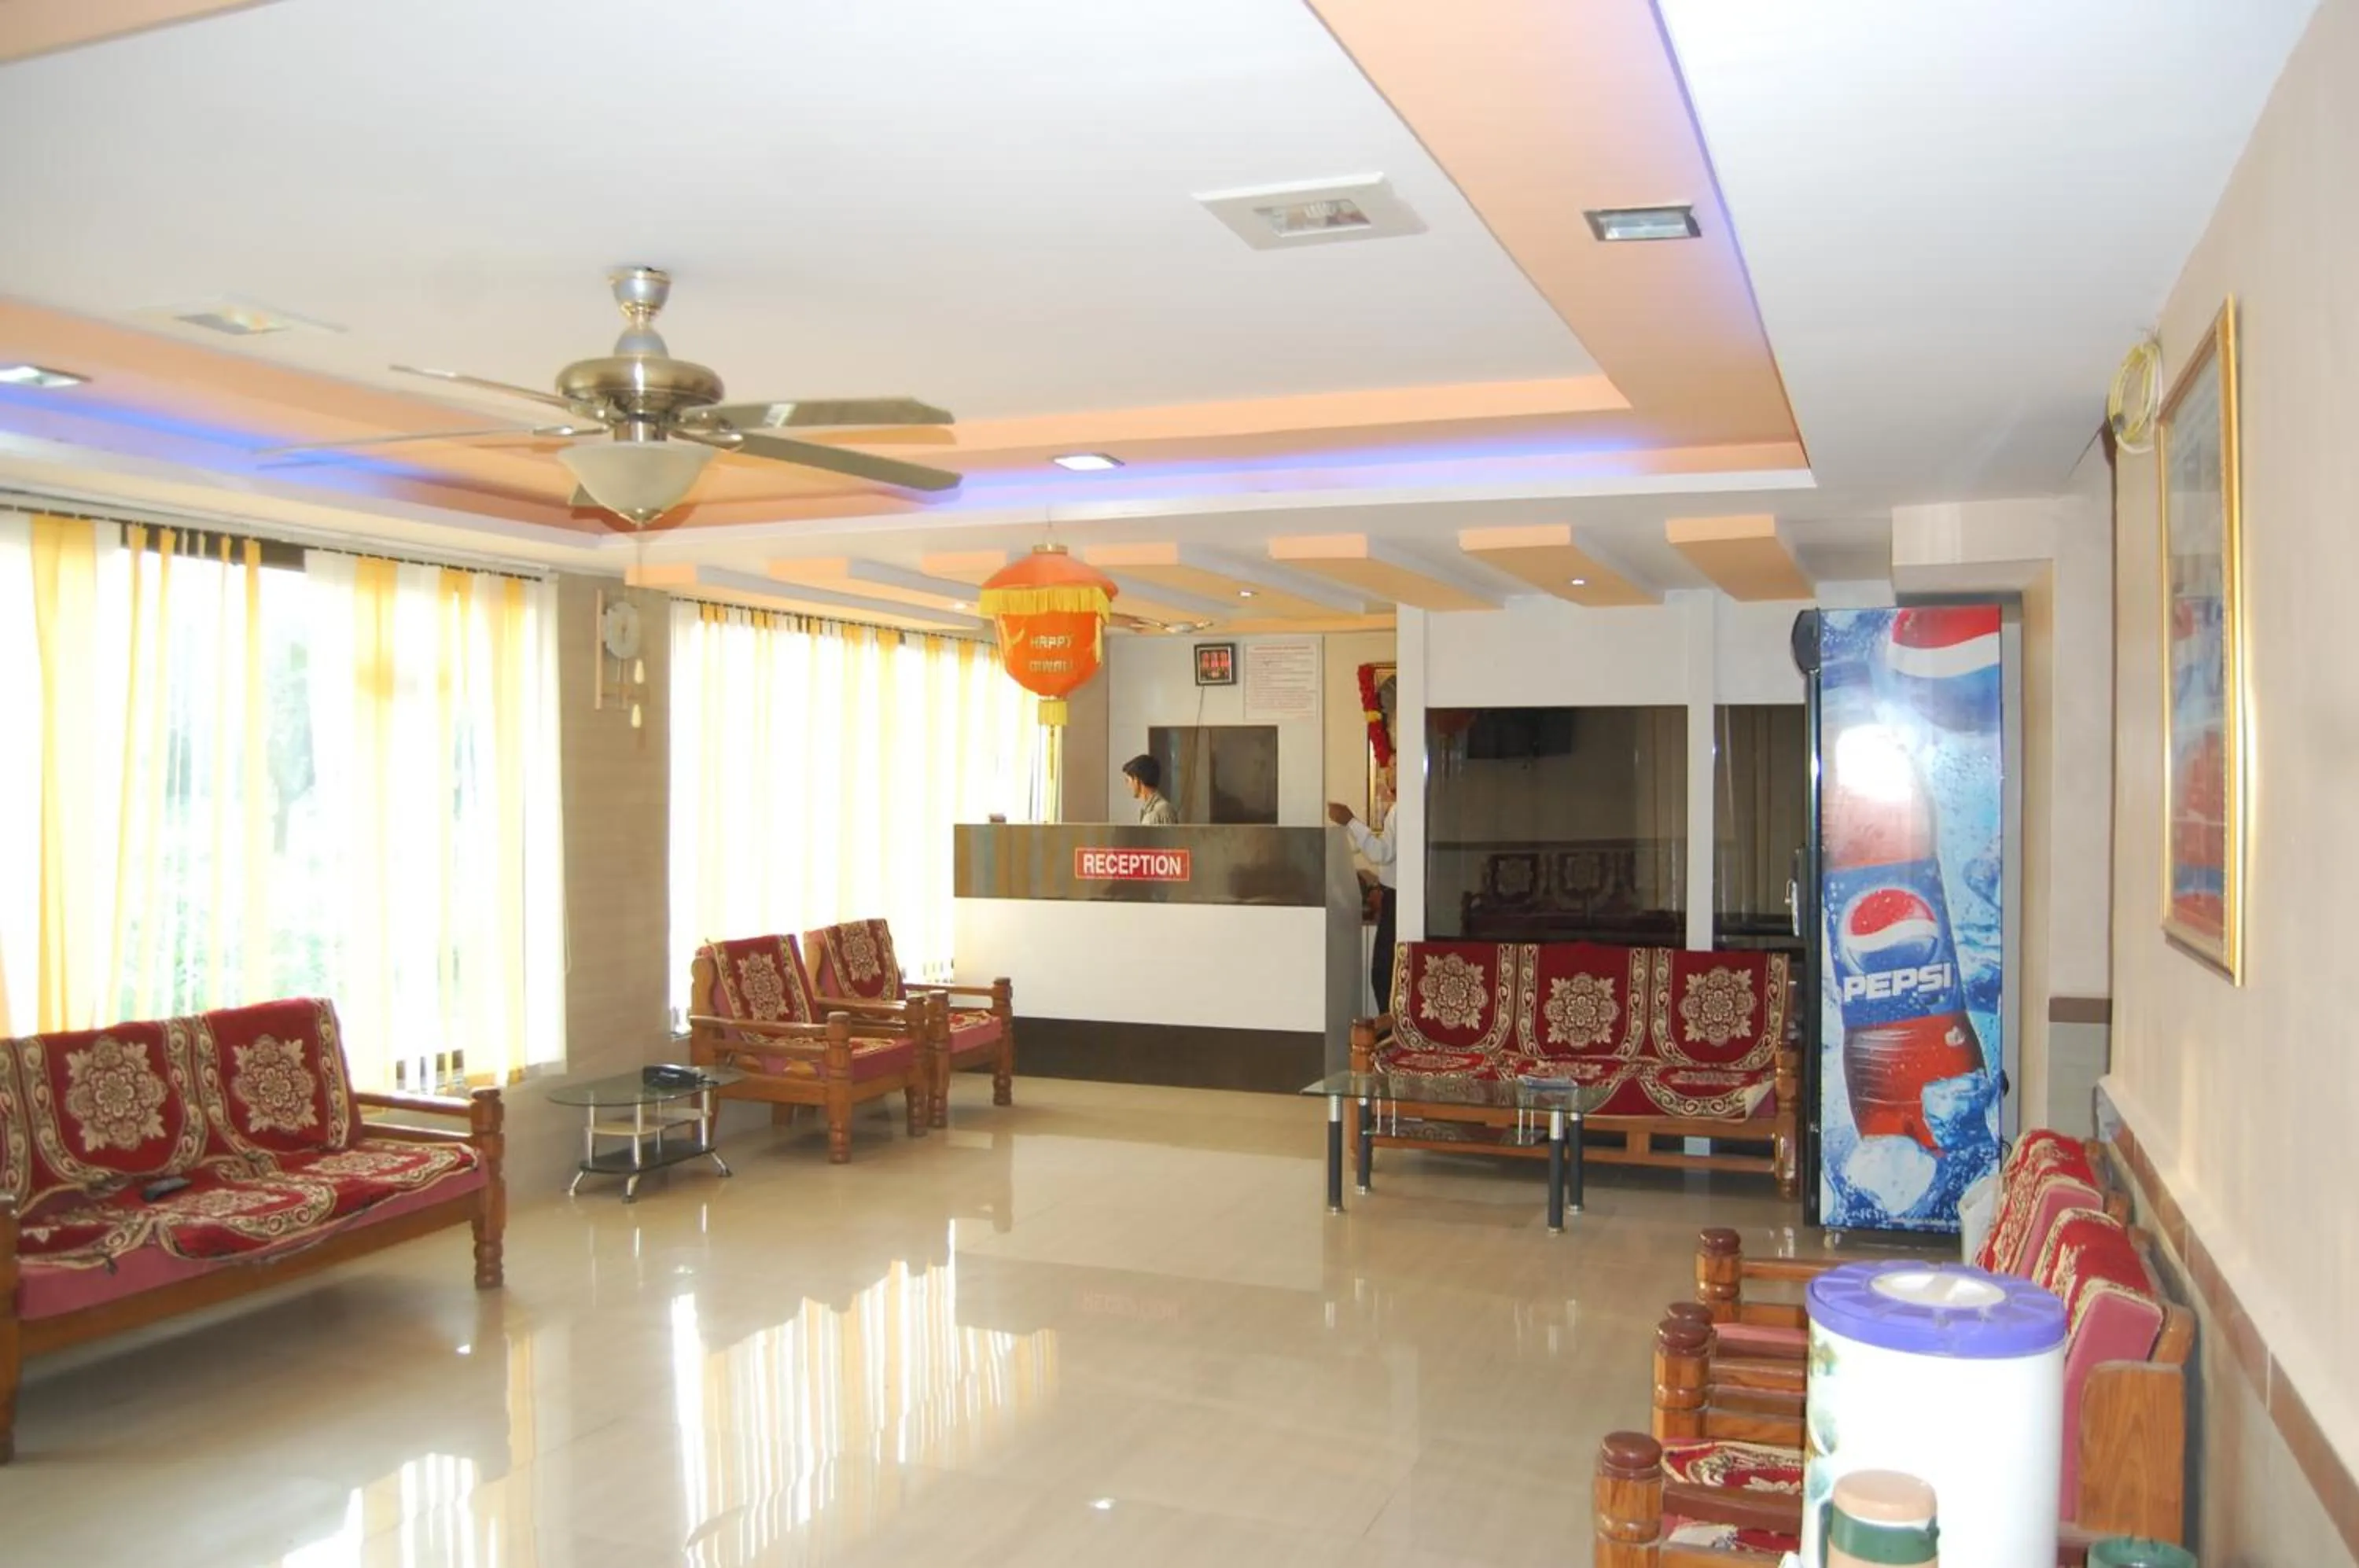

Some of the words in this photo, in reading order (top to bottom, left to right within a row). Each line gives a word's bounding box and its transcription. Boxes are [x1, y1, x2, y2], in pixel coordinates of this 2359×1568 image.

[1031, 634, 1073, 649] HAPPY
[1083, 853, 1181, 875] RECEPTION
[1843, 962, 1952, 1003] PEPSI
